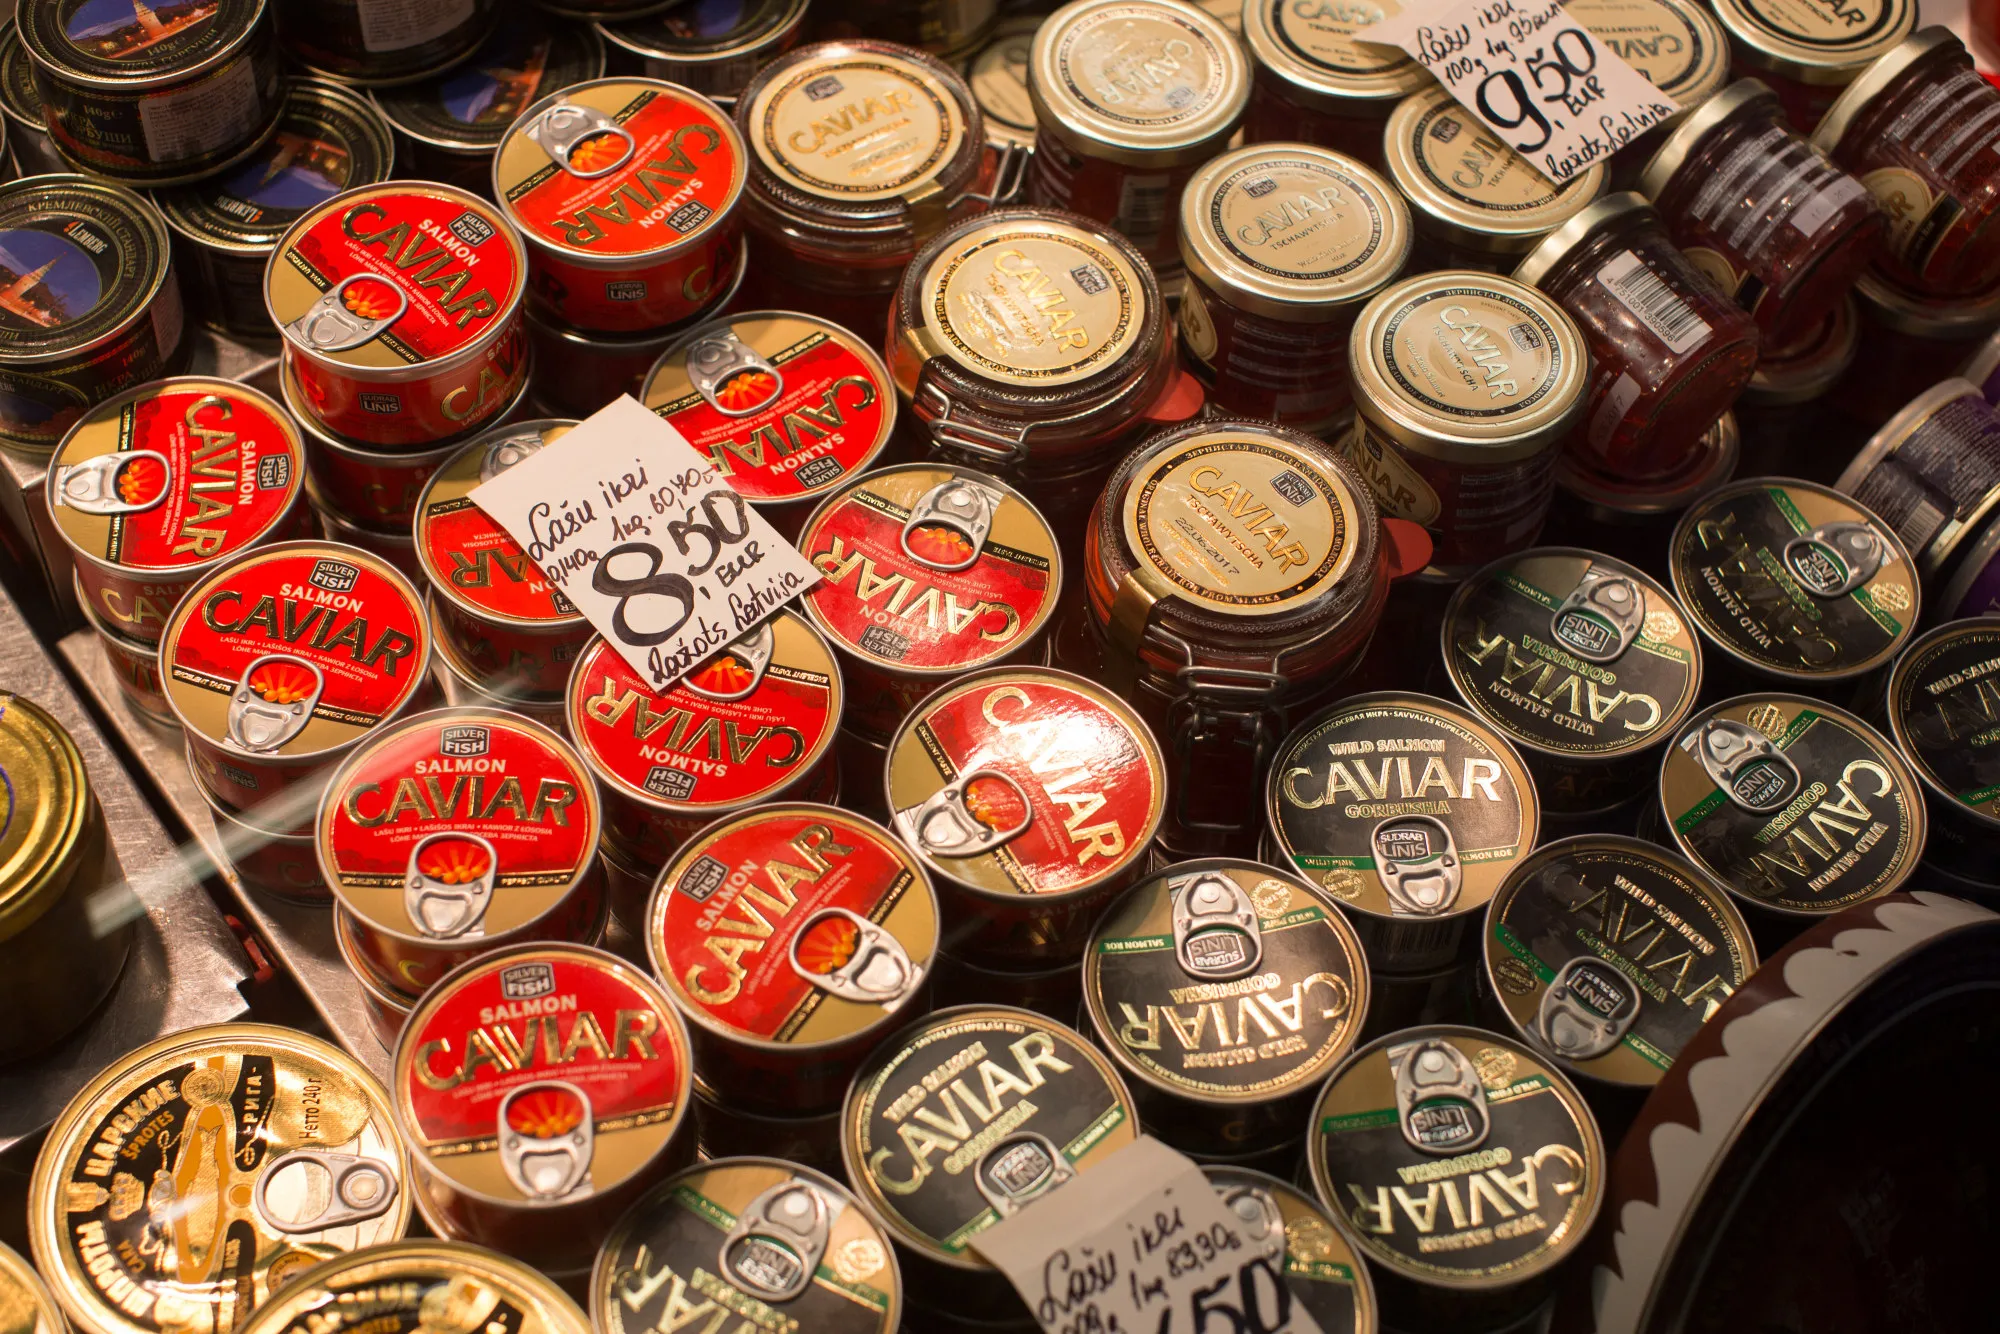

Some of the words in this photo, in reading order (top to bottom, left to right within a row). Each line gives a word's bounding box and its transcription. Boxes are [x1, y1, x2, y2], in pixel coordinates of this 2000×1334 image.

[788, 89, 920, 155] CAVIAR
[552, 123, 721, 246] CAVIAR
[638, 178, 703, 229] SALMON
[670, 203, 700, 228] FISH
[679, 208, 710, 233] SILVER
[1238, 187, 1350, 246] CAVIAR
[418, 219, 480, 267] SALMON
[453, 220, 481, 245] FISH
[463, 214, 491, 238] SILVER
[341, 203, 498, 331] CAVIAR
[993, 249, 1090, 354] CAVIAR
[1439, 304, 1520, 400] CAVIAR
[276, 456, 287, 487] SILVER
[770, 432, 845, 476] SALMON
[800, 455, 835, 478] FISH
[171, 395, 238, 557] CAVIAR
[238, 440, 256, 506] SALMON
[261, 457, 275, 488] FISH
[806, 465, 842, 486] SILVER
[1275, 478, 1305, 505] LINIS
[1185, 494, 1265, 571] TSCHAWYTSCHA
[1188, 464, 1311, 576] CAVIAR
[313, 574, 352, 590] FISH
[318, 562, 356, 579] SILVER
[279, 583, 364, 613] SALMON
[811, 536, 1021, 642] CAVIAR
[1700, 567, 1745, 620] SALMON
[202, 590, 415, 677] CAVIAR
[1566, 617, 1605, 639] LINIS
[1740, 615, 1773, 648] WILD
[1457, 616, 1662, 732] CAVIAR
[1522, 634, 1617, 686] GORBUSHA
[1488, 681, 1552, 718] SALMON
[445, 729, 486, 739] SILVER
[585, 676, 806, 768] CAVIAR
[1552, 714, 1595, 736] WILD
[444, 740, 485, 754] FISH
[638, 744, 728, 777] SALMON
[1328, 740, 1374, 756] WILD
[1377, 739, 1446, 752] SALMON
[415, 759, 506, 774] SALMON
[652, 769, 692, 787] FISH
[1283, 756, 1503, 810] CAVIAR
[345, 776, 577, 828] CAVIAR
[649, 781, 688, 797] SILVER
[1345, 800, 1452, 818] GORBUSHA
[1754, 782, 1828, 844] GORBUSHA
[1380, 832, 1424, 843] SUDRAB
[1381, 843, 1427, 857] LINIS
[1493, 848, 1513, 858] ROE
[1856, 821, 1889, 853] WILD
[682, 857, 711, 892] SILVER
[692, 867, 724, 901] FISH
[1808, 849, 1862, 894] SALMON
[695, 859, 759, 931] SALMON
[684, 823, 856, 1006] CAVIAR
[1614, 874, 1656, 909] WILD
[1654, 904, 1716, 956] SALMON
[1191, 935, 1236, 953] LINIS
[506, 966, 549, 980] SILVER
[506, 978, 550, 996] FISH
[479, 994, 578, 1025] SALMON
[1118, 971, 1350, 1051] CAVIAR
[1571, 975, 1618, 1016] LINIS
[414, 1009, 660, 1091] CAVIAR
[85, 1079, 181, 1177] ЦАРСКИЕ
[298, 1107, 318, 1139] Нетто
[869, 1032, 1074, 1196] CAVIAR
[1415, 1108, 1460, 1130] LINIS
[1347, 1143, 1585, 1234] CAVIAR
[76, 1220, 154, 1318] ШПРОТЫ
